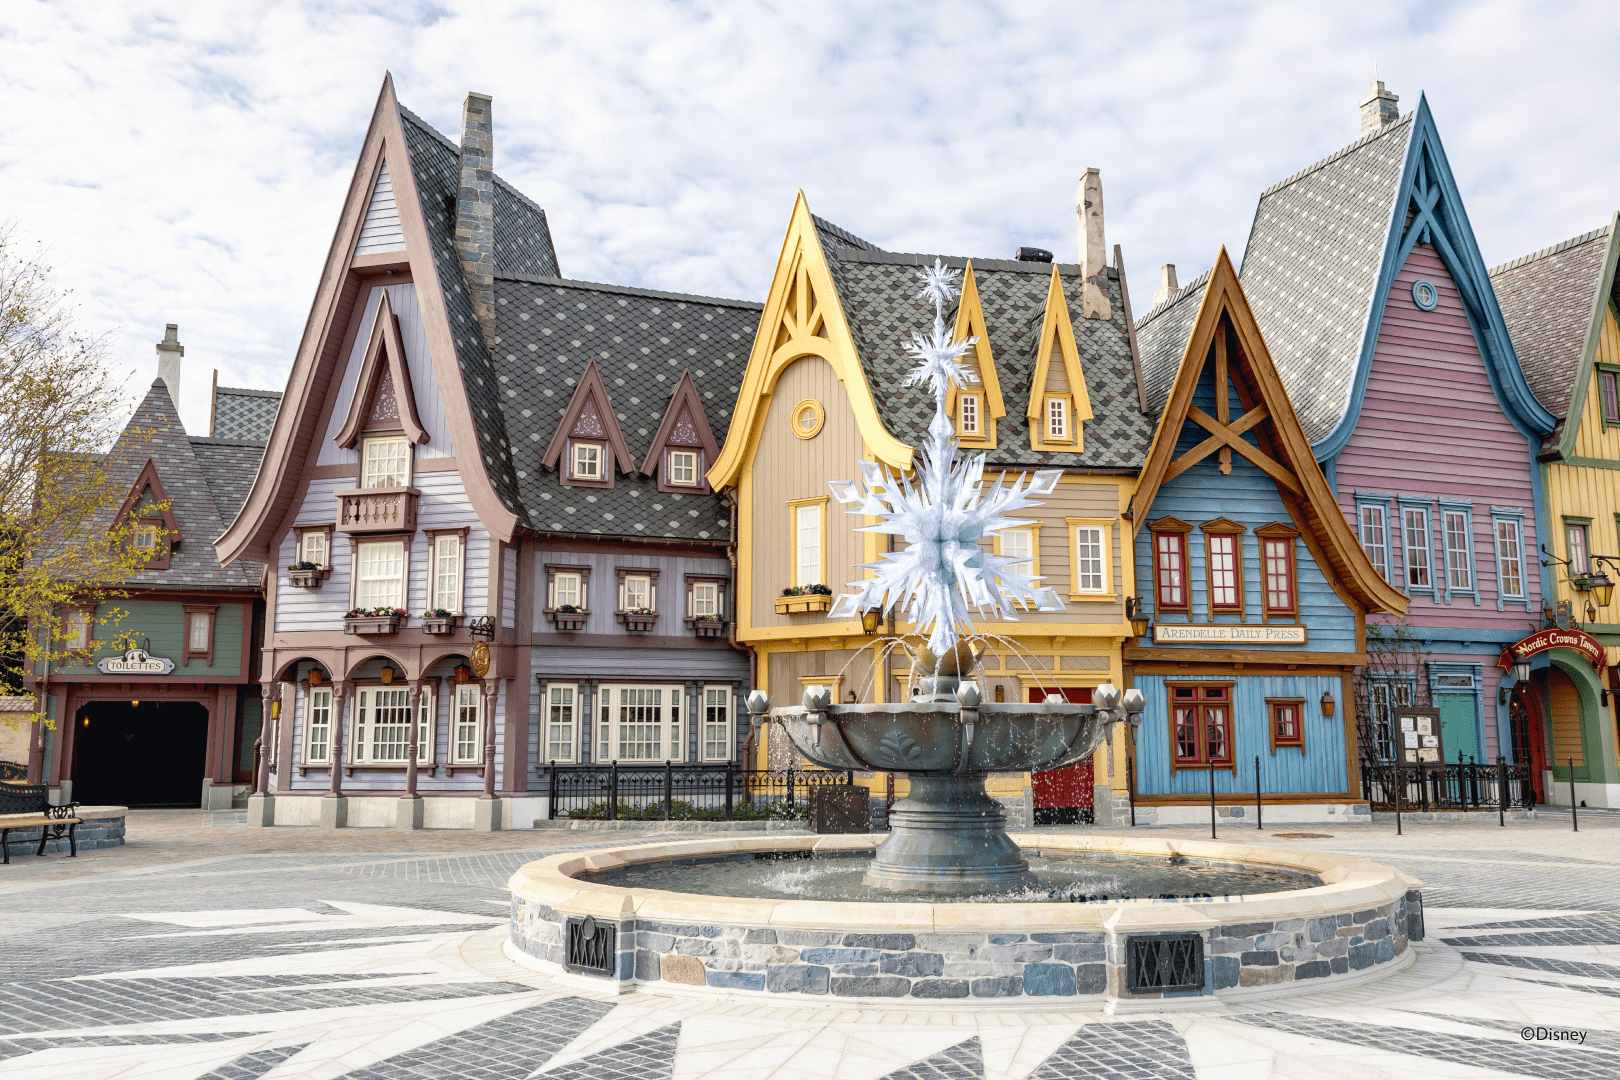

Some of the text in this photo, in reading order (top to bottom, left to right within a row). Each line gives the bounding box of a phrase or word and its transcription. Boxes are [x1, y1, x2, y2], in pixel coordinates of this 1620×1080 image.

[1162, 627, 1300, 640] ARENDELLE DAILY PRESS
[1517, 632, 1600, 658] Nordic Crowns Tavern
[111, 661, 161, 670] TOILETTES
